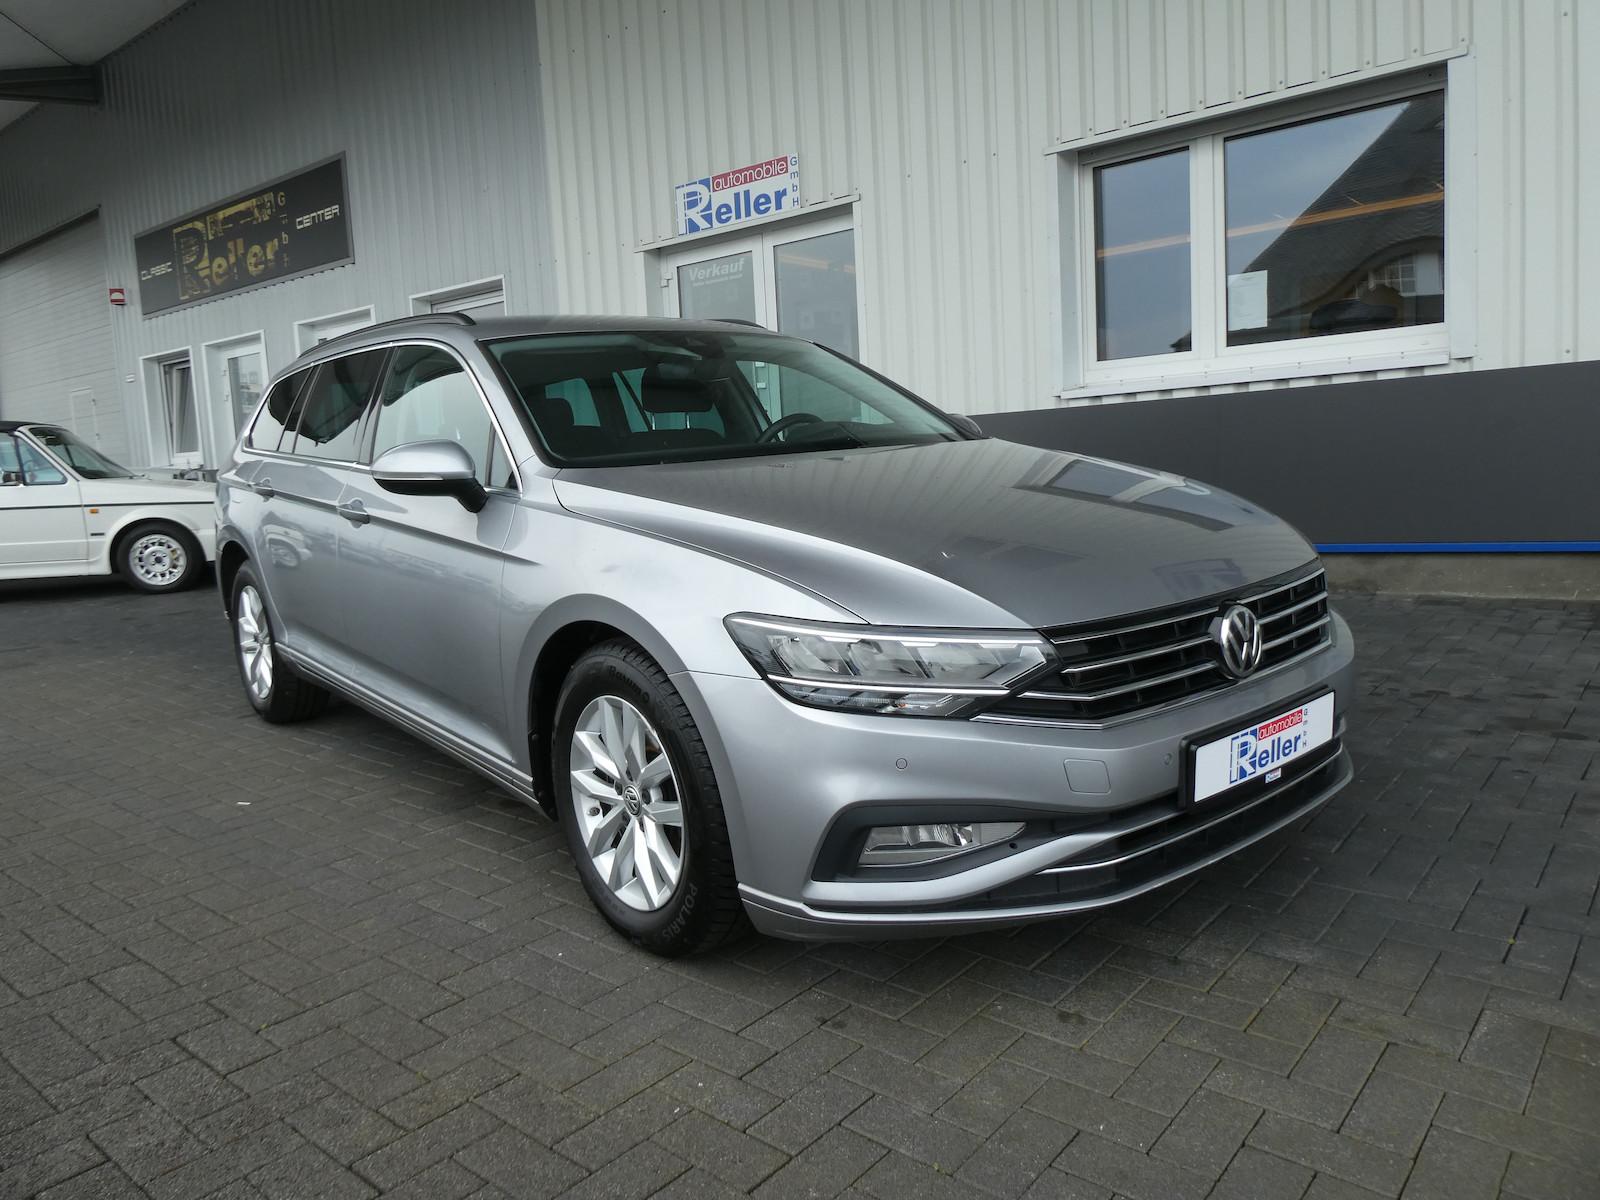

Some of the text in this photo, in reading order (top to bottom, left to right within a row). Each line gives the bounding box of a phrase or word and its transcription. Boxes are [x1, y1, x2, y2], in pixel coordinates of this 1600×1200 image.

[713, 160, 787, 191] automobile
[295, 203, 341, 230] CENTER
[675, 178, 788, 236] Reller
[688, 257, 745, 281] Verkauf
[1259, 711, 1303, 740] automobile
[1230, 727, 1301, 784] Reller
[661, 882, 698, 942] POLARIS
